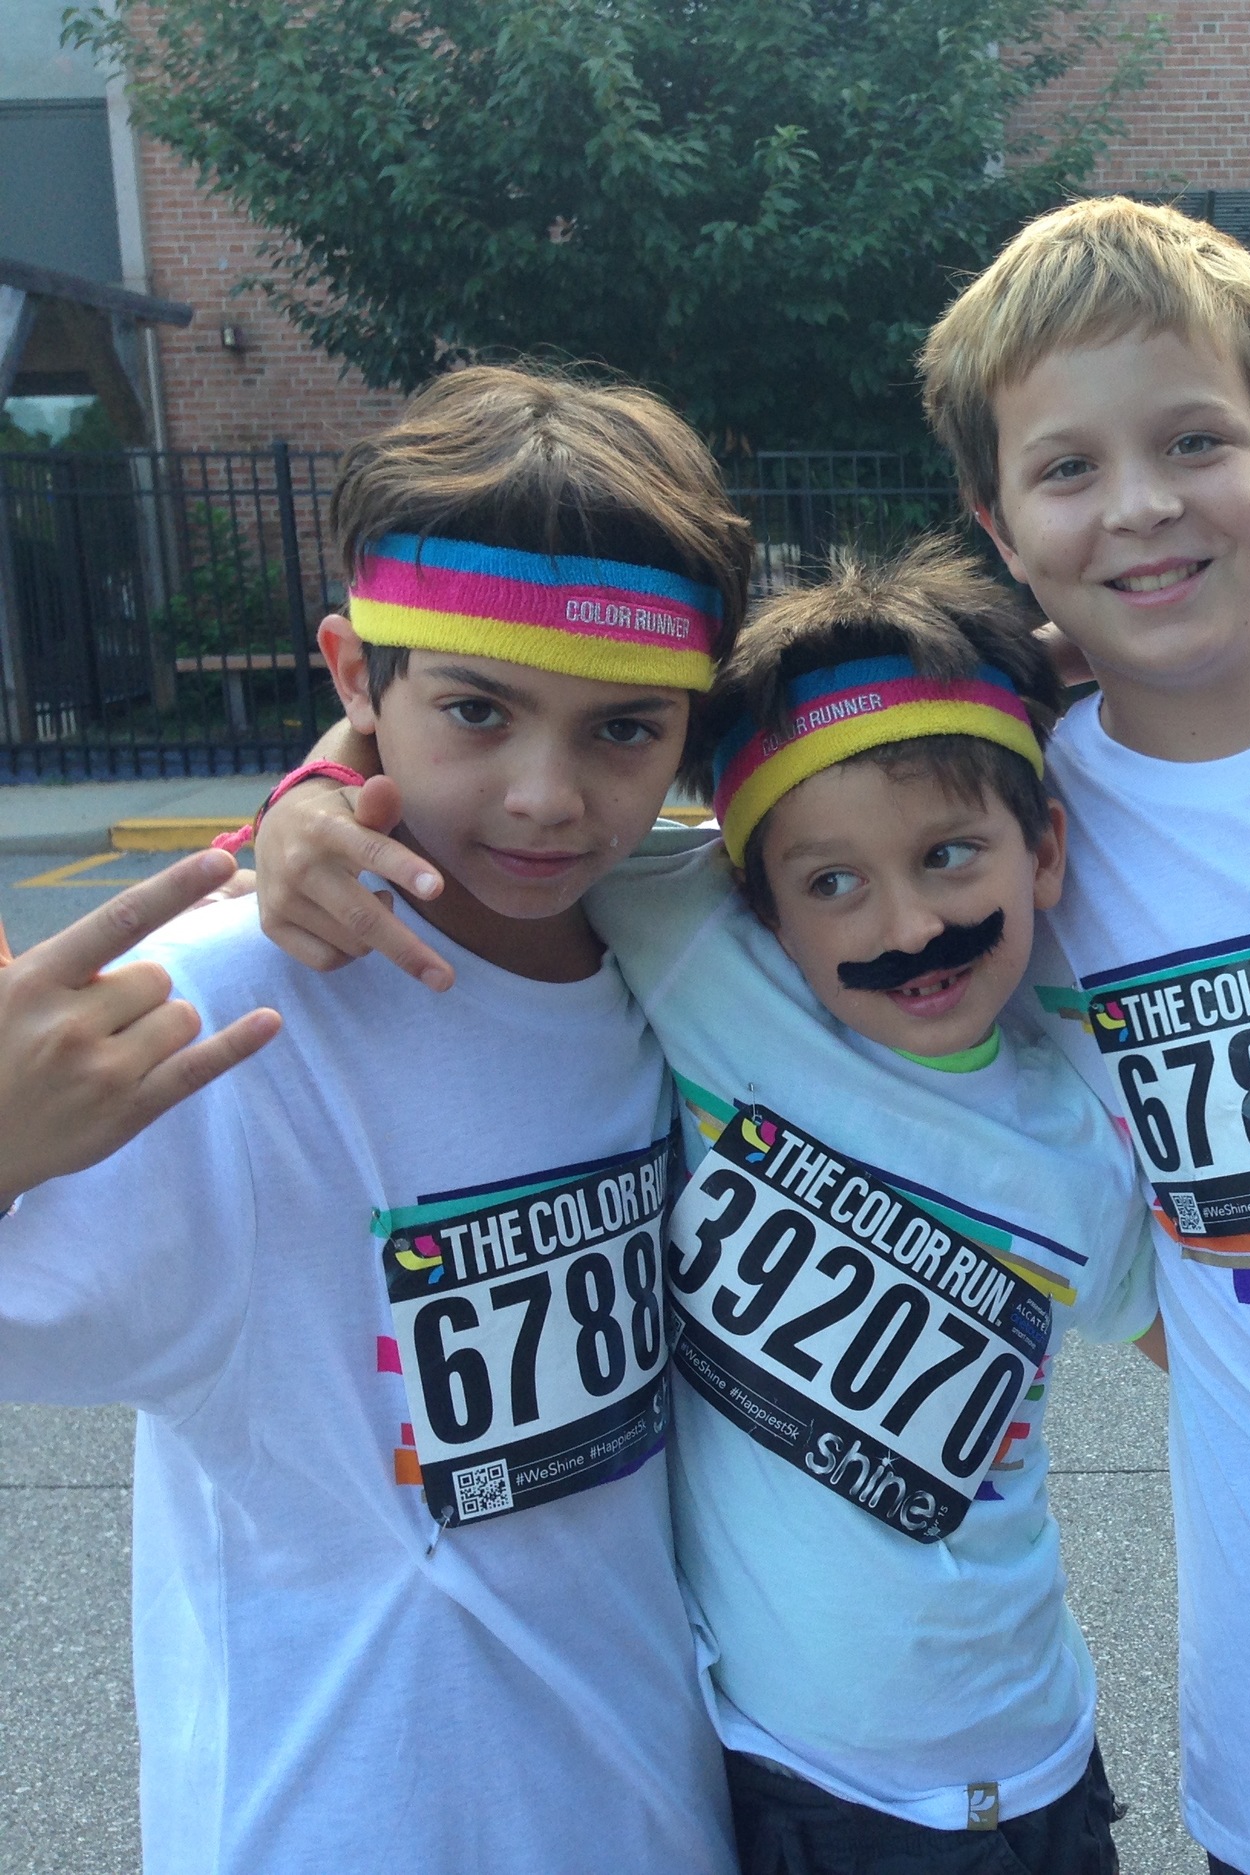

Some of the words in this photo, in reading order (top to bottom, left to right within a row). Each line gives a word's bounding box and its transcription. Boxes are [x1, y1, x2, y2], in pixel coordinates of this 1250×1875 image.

[565, 600, 632, 629] COLOR
[634, 608, 690, 639] RUNNER
[762, 716, 808, 757] COR
[809, 693, 883, 728] RUNNER
[1120, 985, 1191, 1042] THE
[440, 1209, 527, 1280] THE
[528, 1172, 639, 1256] COLOR
[765, 1130, 845, 1208] THE
[830, 1177, 951, 1280] COLOR
[938, 1246, 1016, 1326] RUN
[414, 1231, 662, 1446] 6788
[669, 1168, 1026, 1479] 392070
[1016, 1303, 1047, 1335] ALCATEL
[680, 1342, 727, 1389] #WeShine
[729, 1386, 800, 1441] #Happiest5k
[515, 1454, 585, 1487] #WeShine
[590, 1418, 647, 1460] #Happiest5k
[805, 1432, 936, 1531] shine
[937, 1505, 949, 1517] 15
